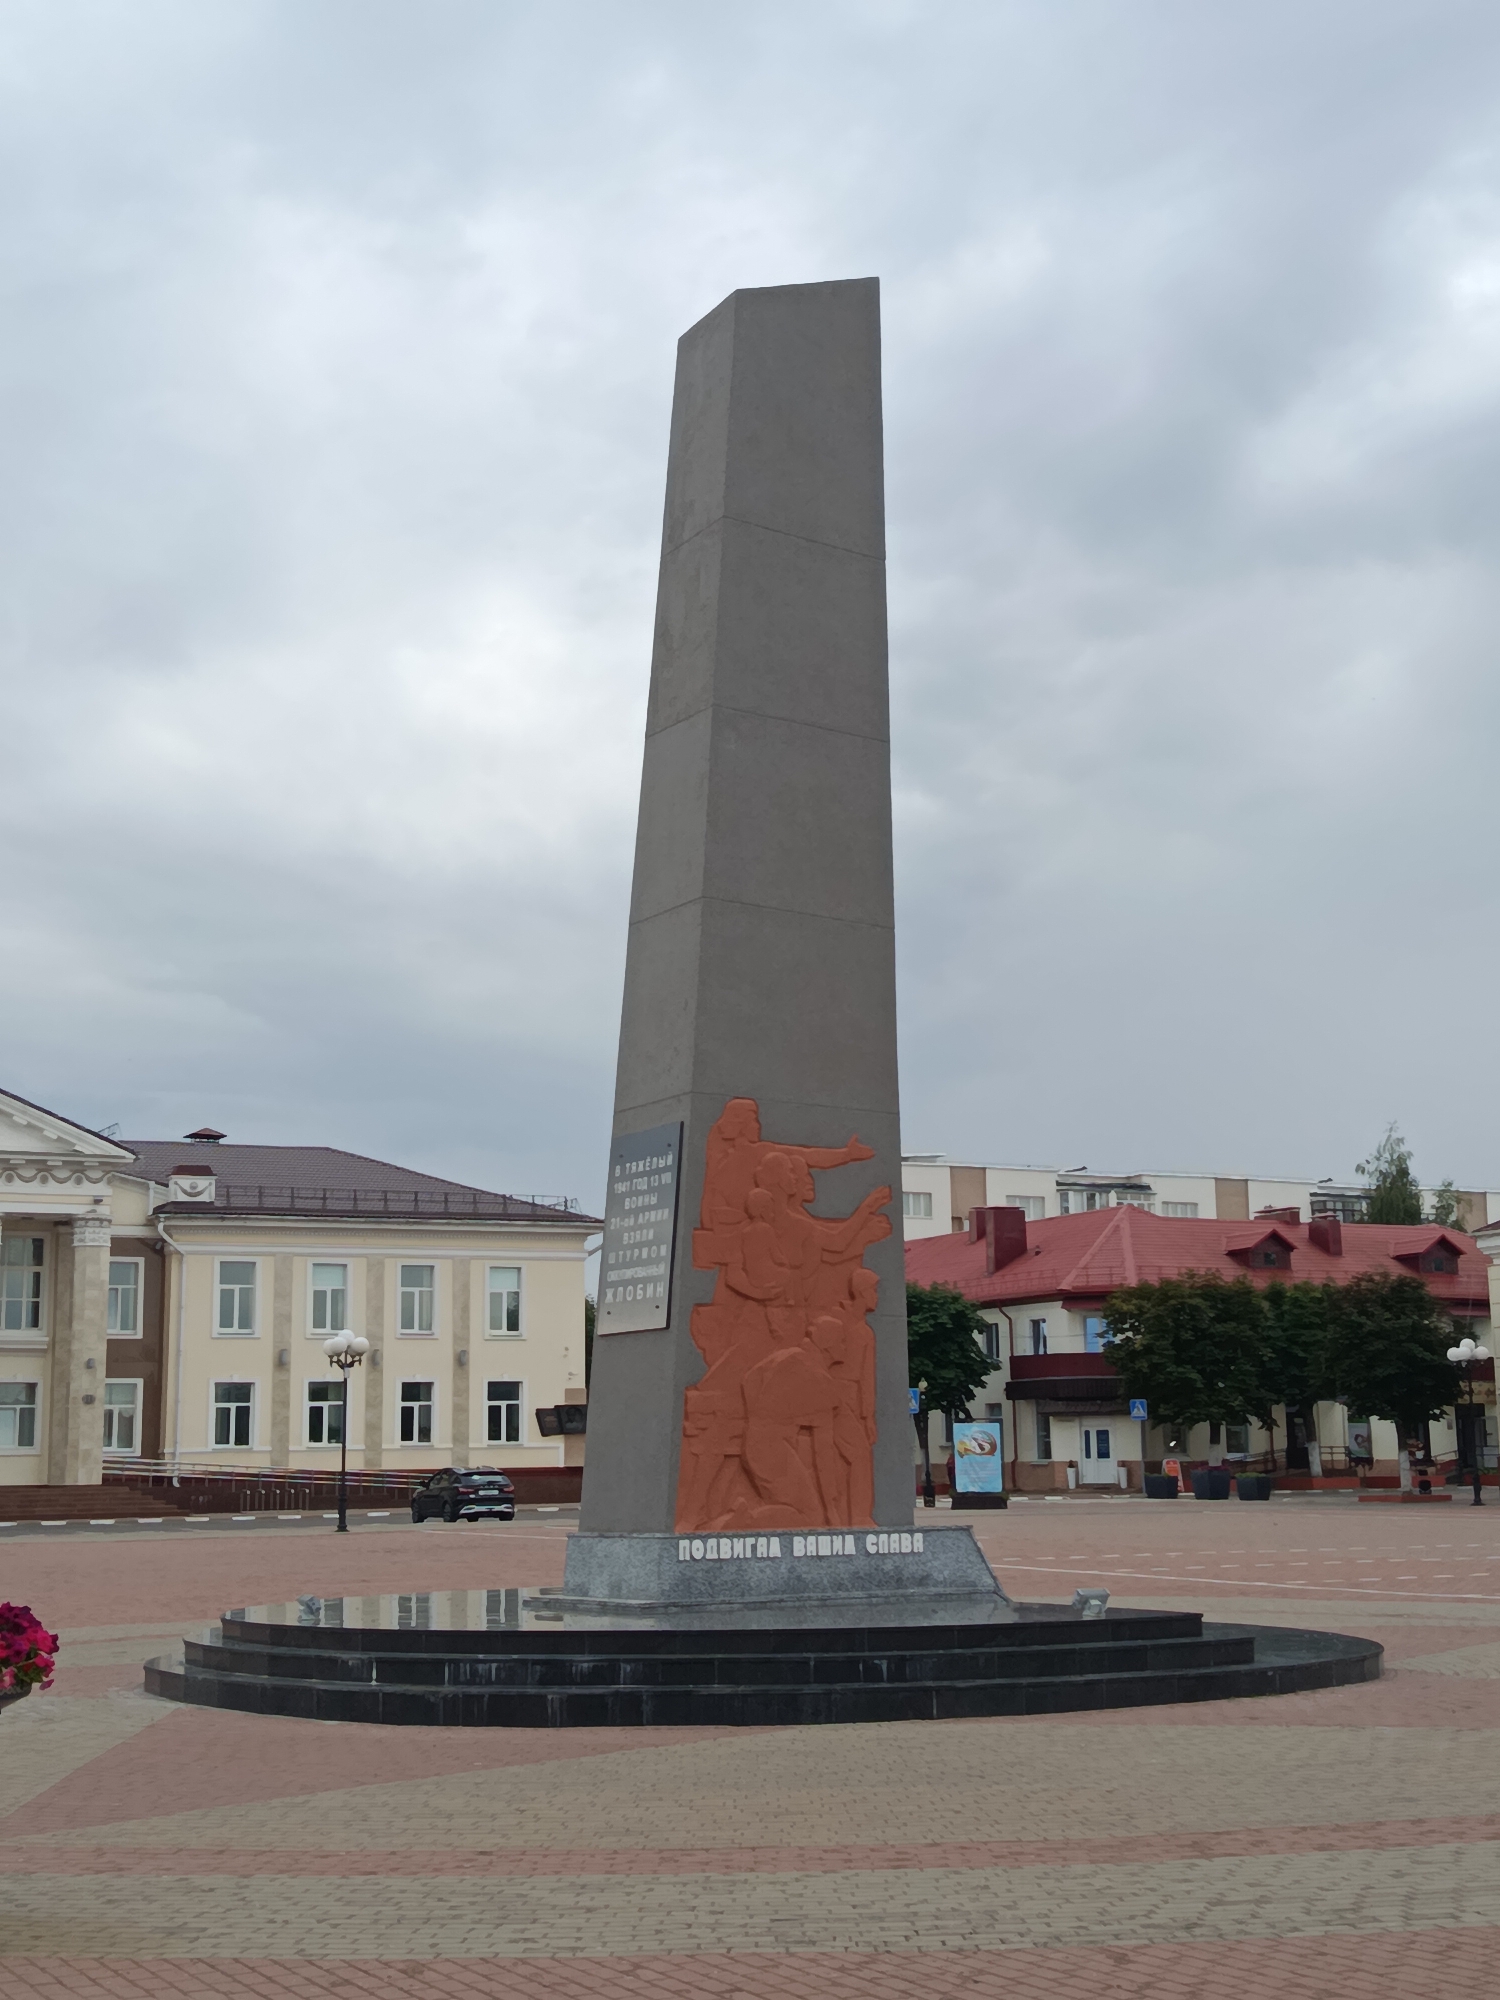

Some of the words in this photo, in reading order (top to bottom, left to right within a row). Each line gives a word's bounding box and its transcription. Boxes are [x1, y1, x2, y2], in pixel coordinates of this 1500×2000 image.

[615, 1165, 621, 1177] В
[625, 1151, 673, 1175] ТЯЖЁЛЫЙ
[614, 1180, 631, 1194] 1941
[632, 1176, 648, 1191] ГОД
[650, 1174, 659, 1187] 13
[624, 1192, 658, 1210] ВОИНЫ
[637, 1208, 669, 1225] АРМИИ
[622, 1228, 654, 1245] ВЗЯЛИ
[608, 1243, 667, 1264] ШТУРМОМ
[604, 1281, 664, 1304] ЖЛОБИН
[865, 1532, 924, 1555] СЛАВА
